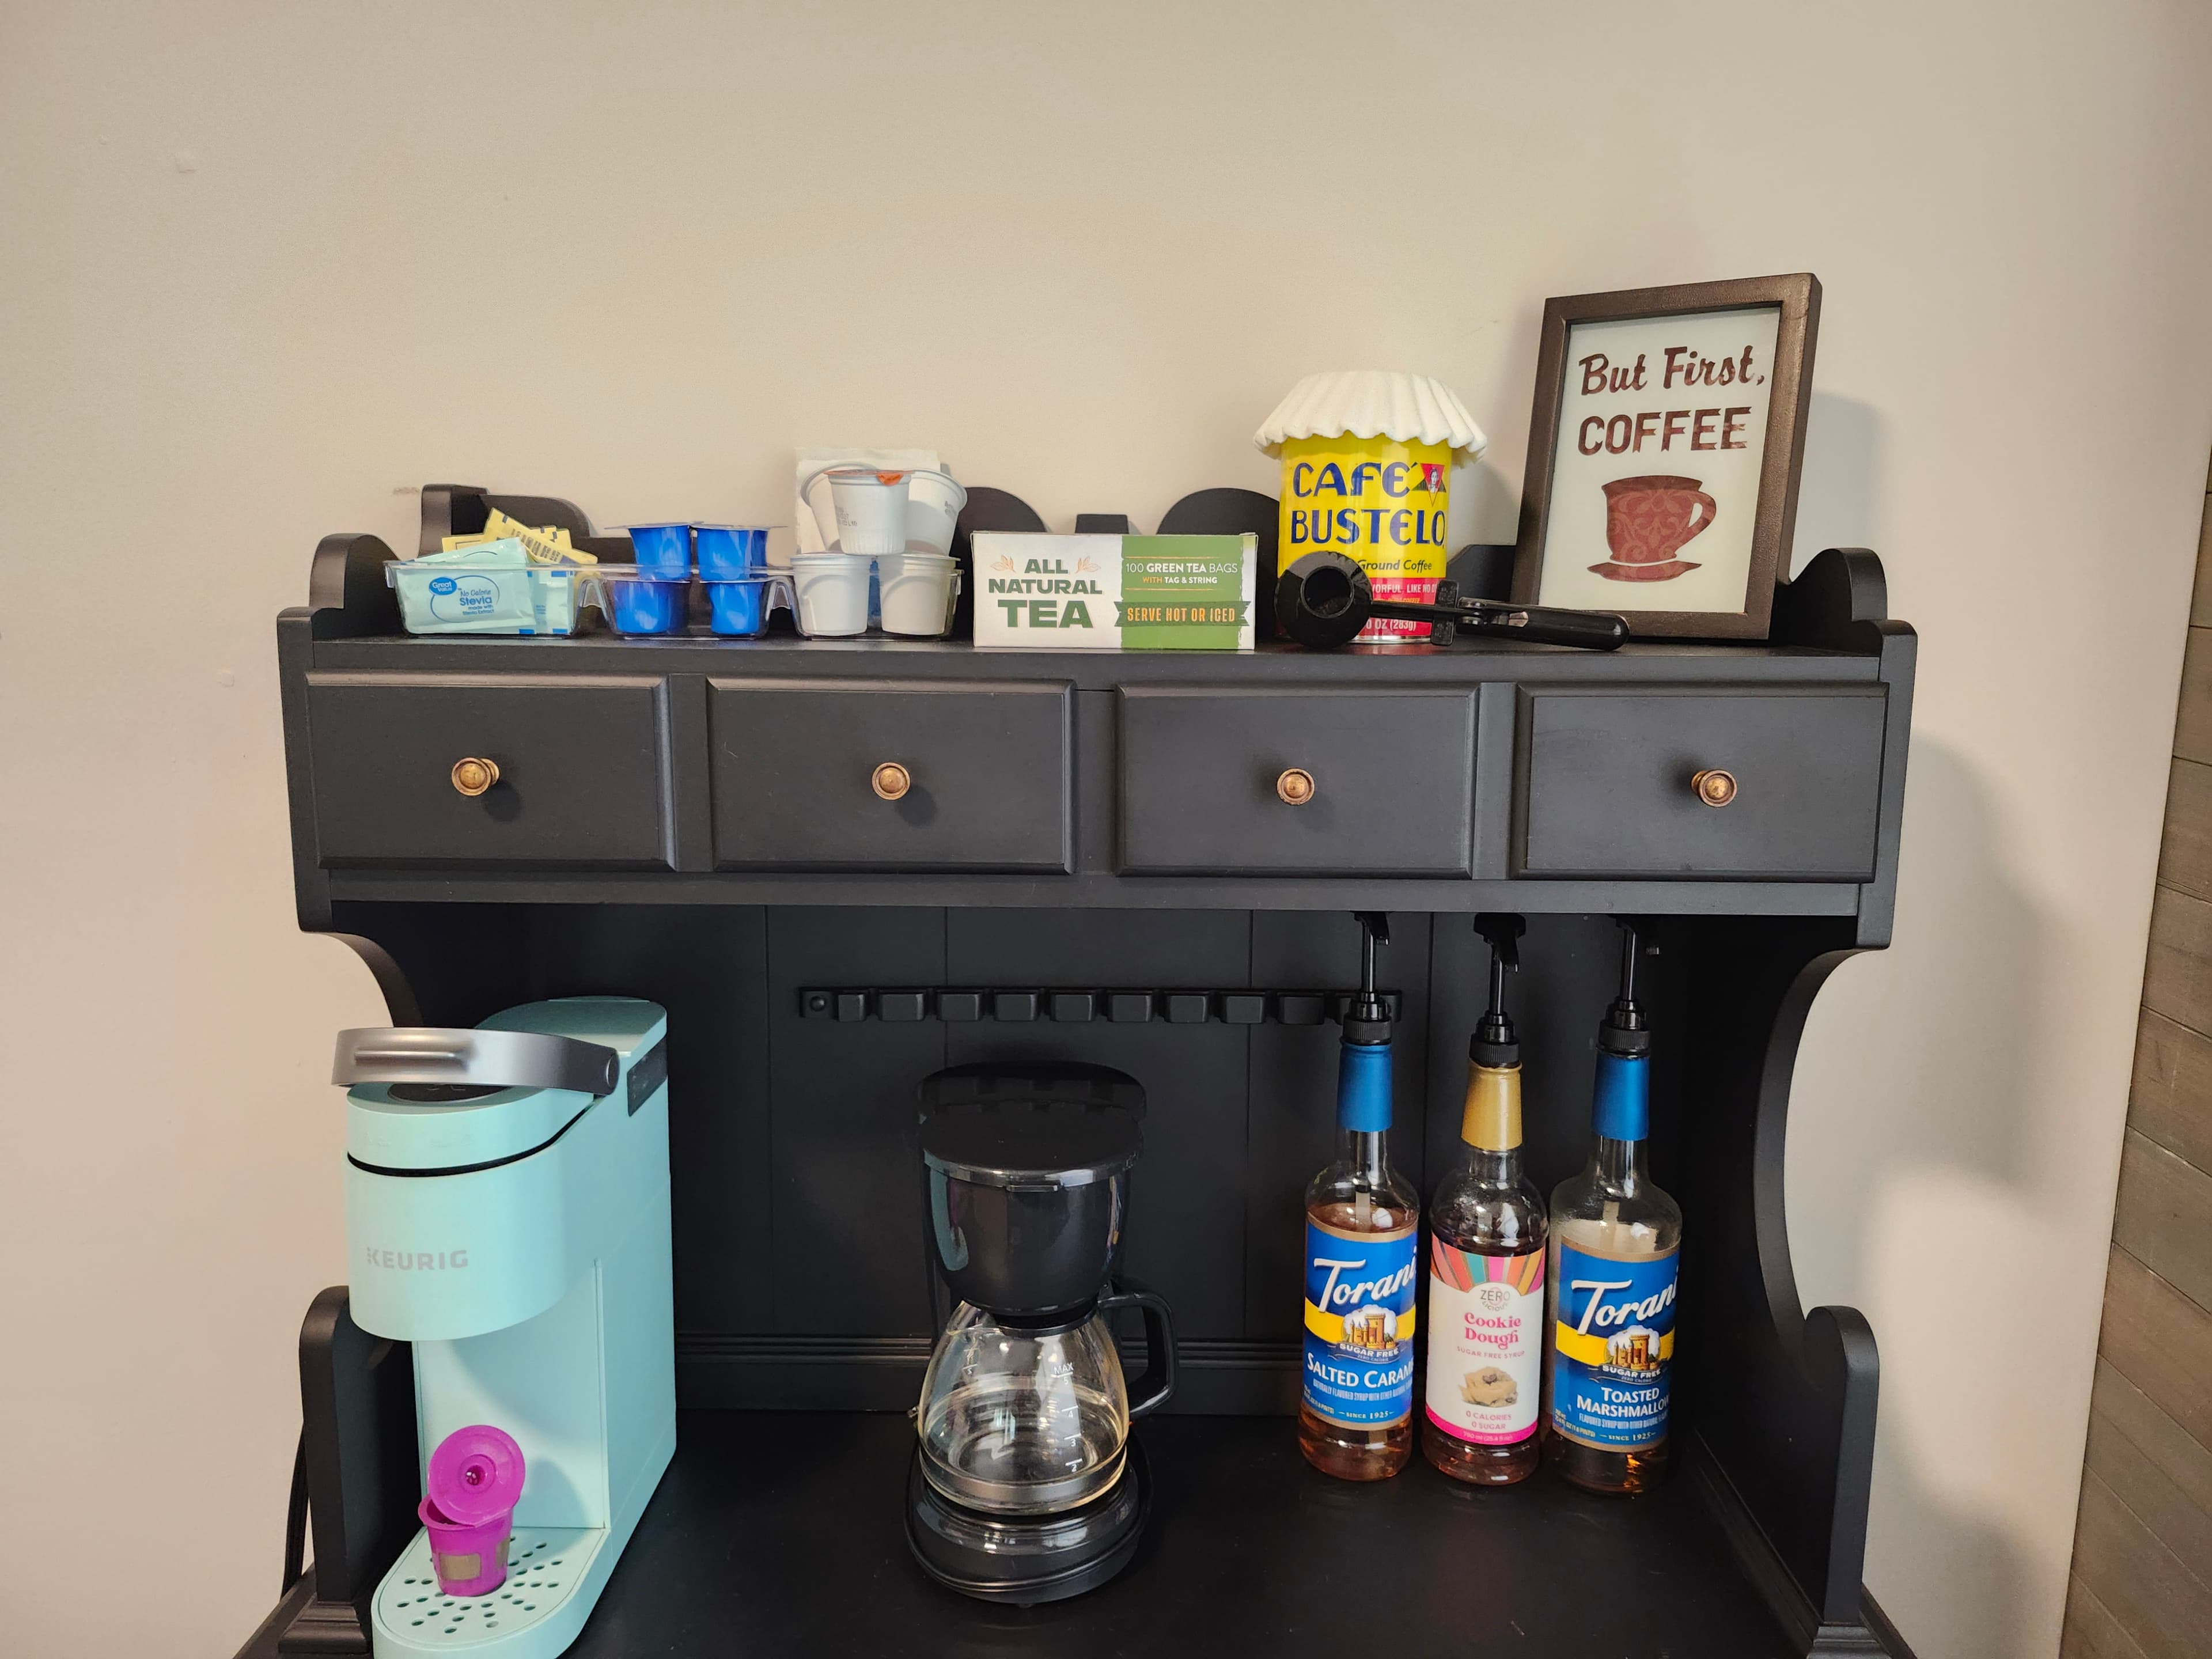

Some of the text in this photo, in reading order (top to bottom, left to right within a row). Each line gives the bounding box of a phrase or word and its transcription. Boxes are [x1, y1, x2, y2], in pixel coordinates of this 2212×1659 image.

[1578, 345, 1765, 395] But First,
[1578, 407, 1752, 455] COFFEE
[1291, 508, 1445, 547] BUSTELO
[1024, 559, 1068, 574] ALL
[1126, 563, 1238, 573] 100 GREEN TEA BAGS
[1358, 560, 1432, 573] Ground Coffee
[988, 578, 1103, 594] NATURAL
[1407, 584, 1421, 593] LIKE
[460, 596, 492, 606] Stevia
[998, 599, 1093, 628] TEA
[1127, 607, 1235, 622] SERVE HOT OR ICED
[1374, 619, 1387, 629] OZ
[1390, 619, 1416, 631] (283g)
[366, 1247, 468, 1270] KEURIG
[1313, 1245, 1417, 1313] Torani
[1480, 1289, 1510, 1301] ZERO
[1464, 1312, 1521, 1328] Cookie
[1465, 1327, 1518, 1350] Dough
[1340, 1343, 1399, 1357] SUGAR FREE
[1457, 1346, 1482, 1357] SUGAR
[1054, 1363, 1074, 1374] MAX
[1308, 1353, 1359, 1387] SALTED
[1603, 1365, 1660, 1378] SUGAR FREE
[1601, 1387, 1659, 1403] TOASTED
[1068, 1410, 1074, 1418] 4
[1370, 1411, 1388, 1419] 1925
[1633, 1432, 1651, 1441] 1925
[1071, 1464, 1077, 1472] 2
